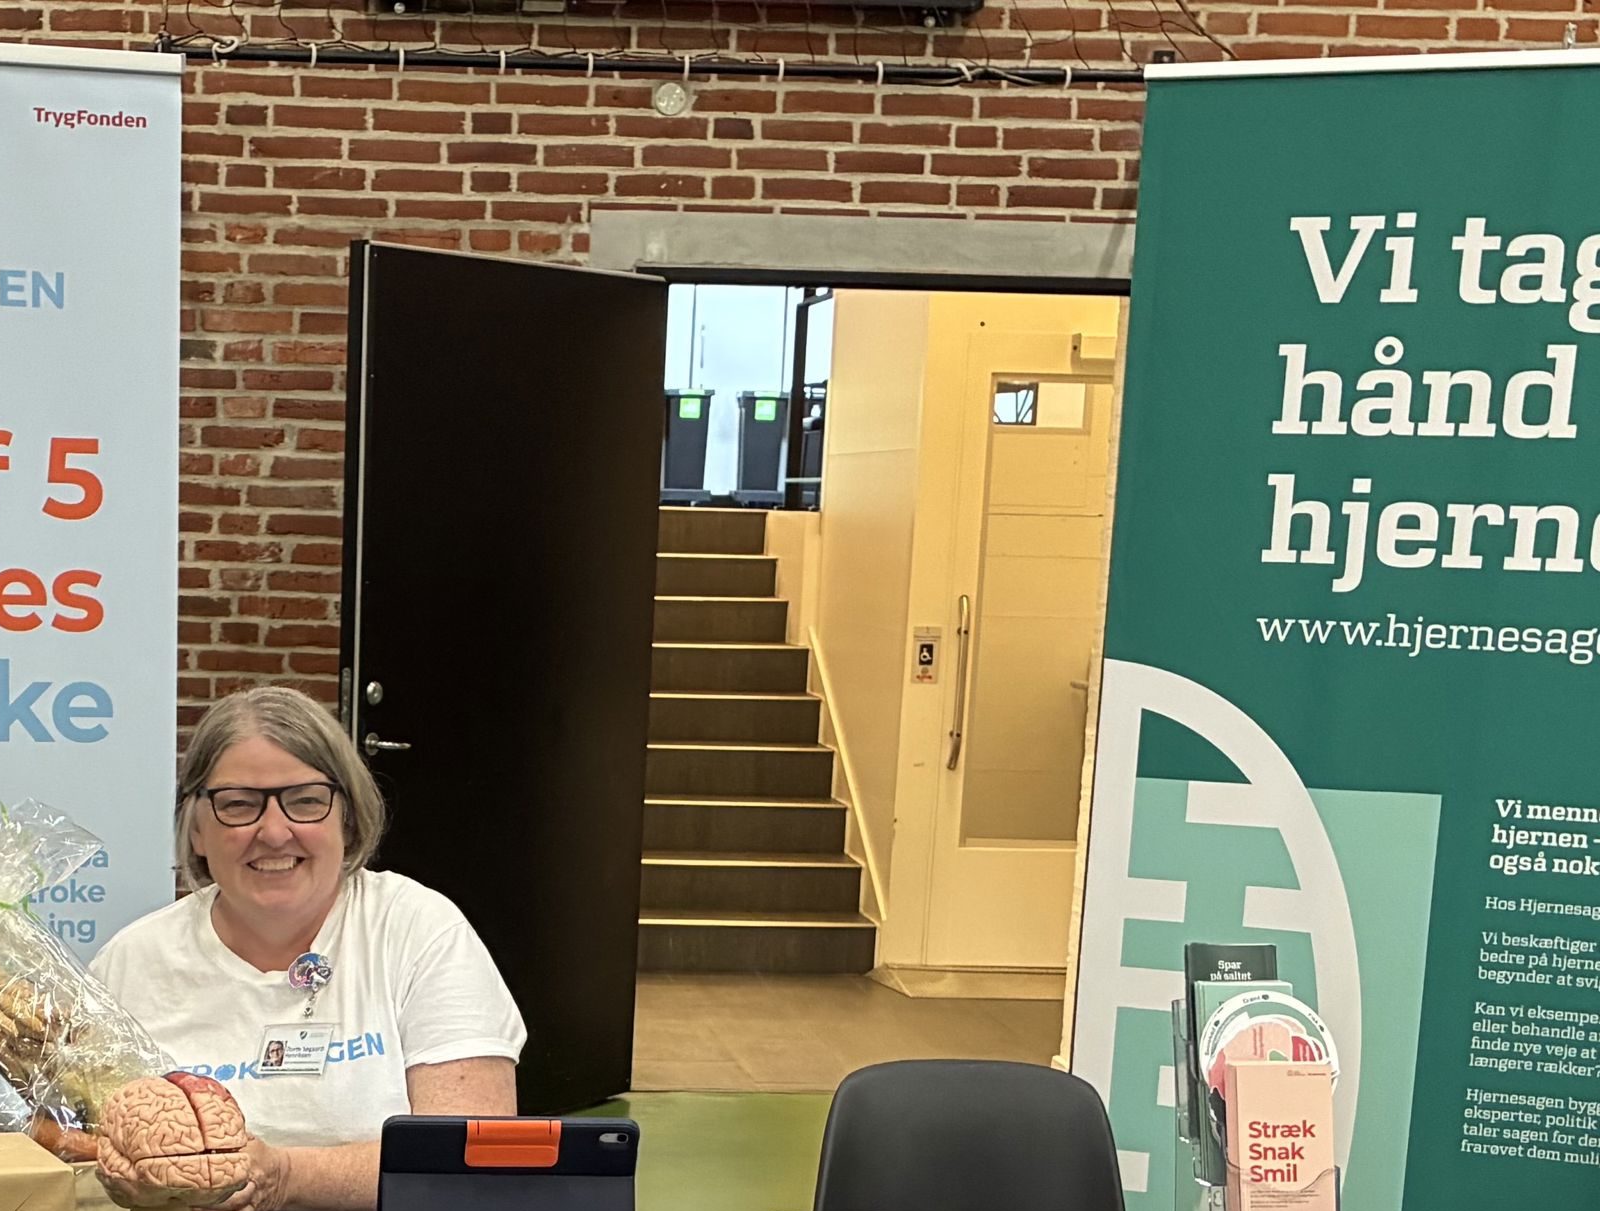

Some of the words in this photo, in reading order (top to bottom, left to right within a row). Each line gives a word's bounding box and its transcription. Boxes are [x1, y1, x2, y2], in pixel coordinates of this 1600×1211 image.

[33, 107, 148, 130] TrygFonden
[1290, 212, 1418, 304] Vi
[1272, 336, 1578, 439] hånd
[42, 437, 104, 521] 5
[1256, 614, 1600, 665] www.hjernesag
[1495, 799, 1522, 818] Vi
[1526, 805, 1600, 823] menn
[1491, 824, 1588, 849] hjernen
[1490, 851, 1547, 875] også
[1485, 896, 1516, 911] Hos
[1482, 931, 1498, 945] Vi
[1502, 932, 1597, 954] beskæftiger
[1218, 960, 1242, 972] Spar
[1480, 948, 1525, 964] bedre
[1528, 952, 1548, 968] på
[1210, 971, 1222, 982] på
[1223, 971, 1252, 981] saltet
[1478, 966, 1553, 984] begynder
[1556, 974, 1573, 986] at
[1576, 975, 1600, 992] svi
[1474, 1001, 1505, 1016] Kan
[1509, 1005, 1524, 1018] vi
[1527, 1005, 1600, 1026] eksempe
[1472, 1019, 1509, 1034] eller
[1511, 1021, 1585, 1041] behandle
[1471, 1036, 1510, 1051] finde
[1513, 1041, 1542, 1056] nye
[1545, 1044, 1577, 1060] veje
[1580, 1047, 1597, 1059] at
[1469, 1053, 1533, 1072] længere
[1466, 1088, 1564, 1110] Hjernesagen
[1464, 1105, 1542, 1125] eksperter,
[1545, 1114, 1598, 1130] politik
[1248, 1120, 1316, 1139] Stræk
[1463, 1122, 1500, 1137] taler
[1503, 1127, 1548, 1144] sagen
[1552, 1130, 1575, 1145] for
[1248, 1142, 1305, 1161] Snak
[1461, 1139, 1525, 1157] frarøvet
[1526, 1145, 1561, 1161] dem
[1564, 1151, 1600, 1168] muli
[1250, 1163, 1298, 1183] Smil
